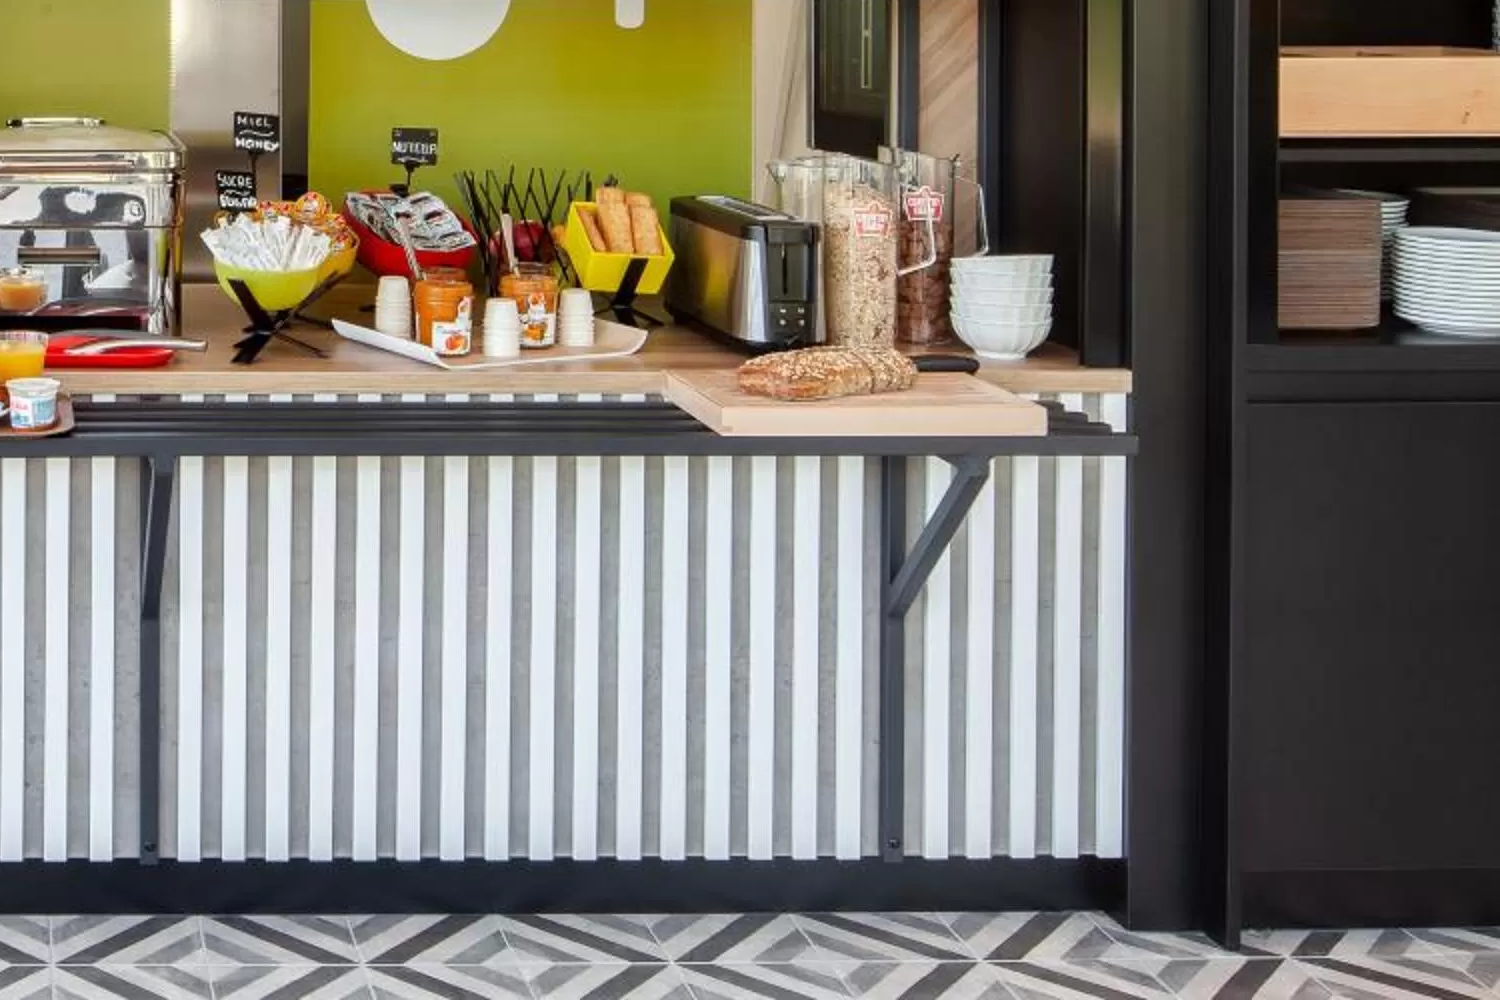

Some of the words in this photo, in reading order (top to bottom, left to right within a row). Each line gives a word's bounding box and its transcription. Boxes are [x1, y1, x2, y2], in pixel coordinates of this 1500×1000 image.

[237, 115, 272, 129] MIEL
[235, 137, 279, 152] HONEY
[217, 173, 253, 189] SUCRE
